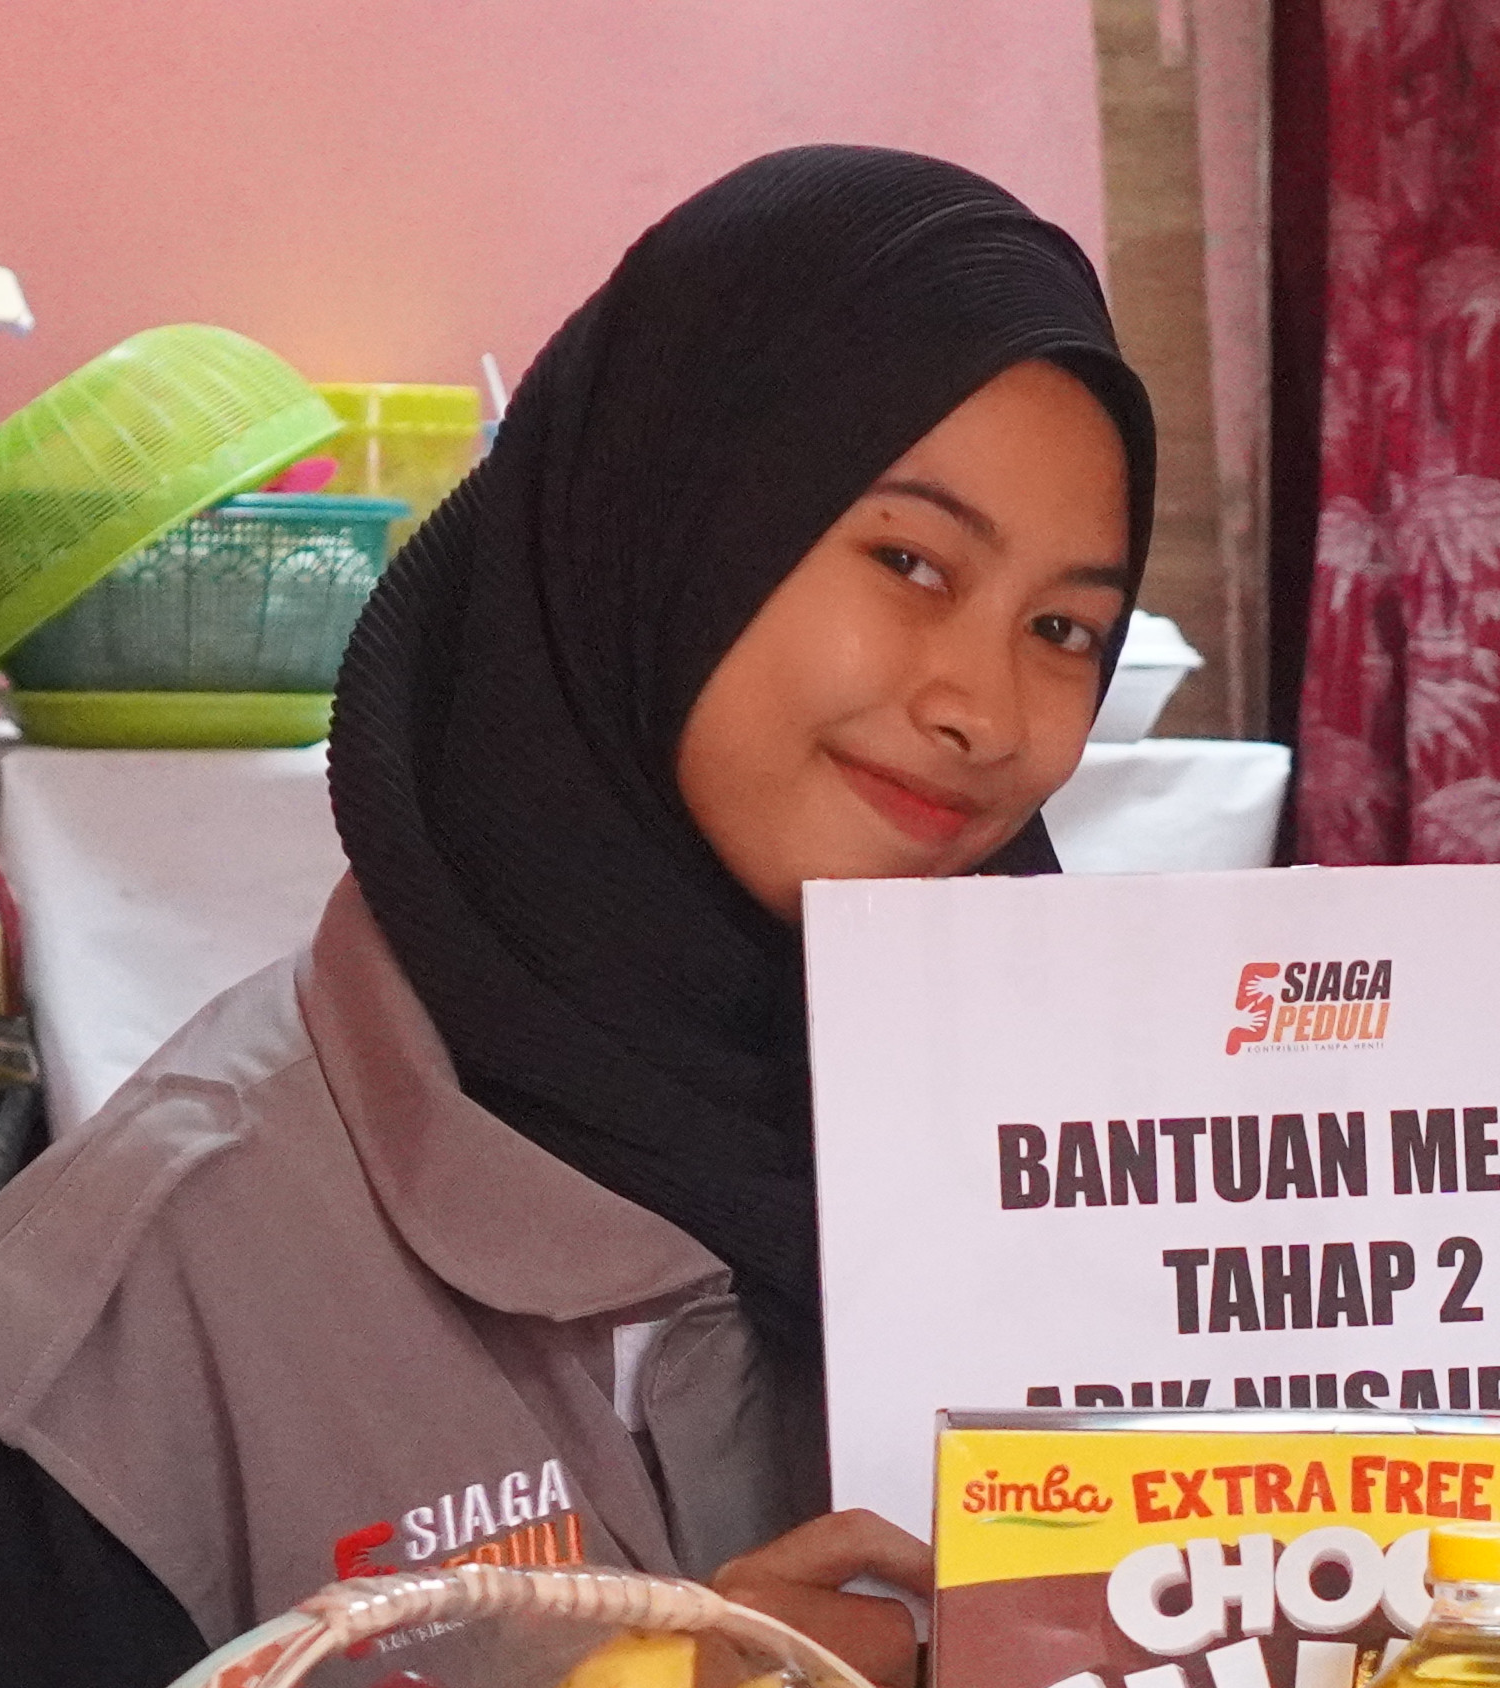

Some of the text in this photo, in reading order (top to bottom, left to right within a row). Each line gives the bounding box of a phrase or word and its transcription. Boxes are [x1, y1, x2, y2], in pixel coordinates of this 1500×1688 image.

[1281, 960, 1392, 1003] SIAGA
[1247, 1043, 1310, 1054] KONTRIBUSI
[1273, 1002, 1390, 1042] PEDULI
[997, 1110, 1368, 1210] BANTUAN
[1163, 1235, 1484, 1334] TAHAP 2
[402, 1459, 572, 1561] SIAGA
[962, 1463, 1113, 1515] simba
[1131, 1460, 1338, 1524] EXTRA
[1351, 1455, 1495, 1521] FREE
